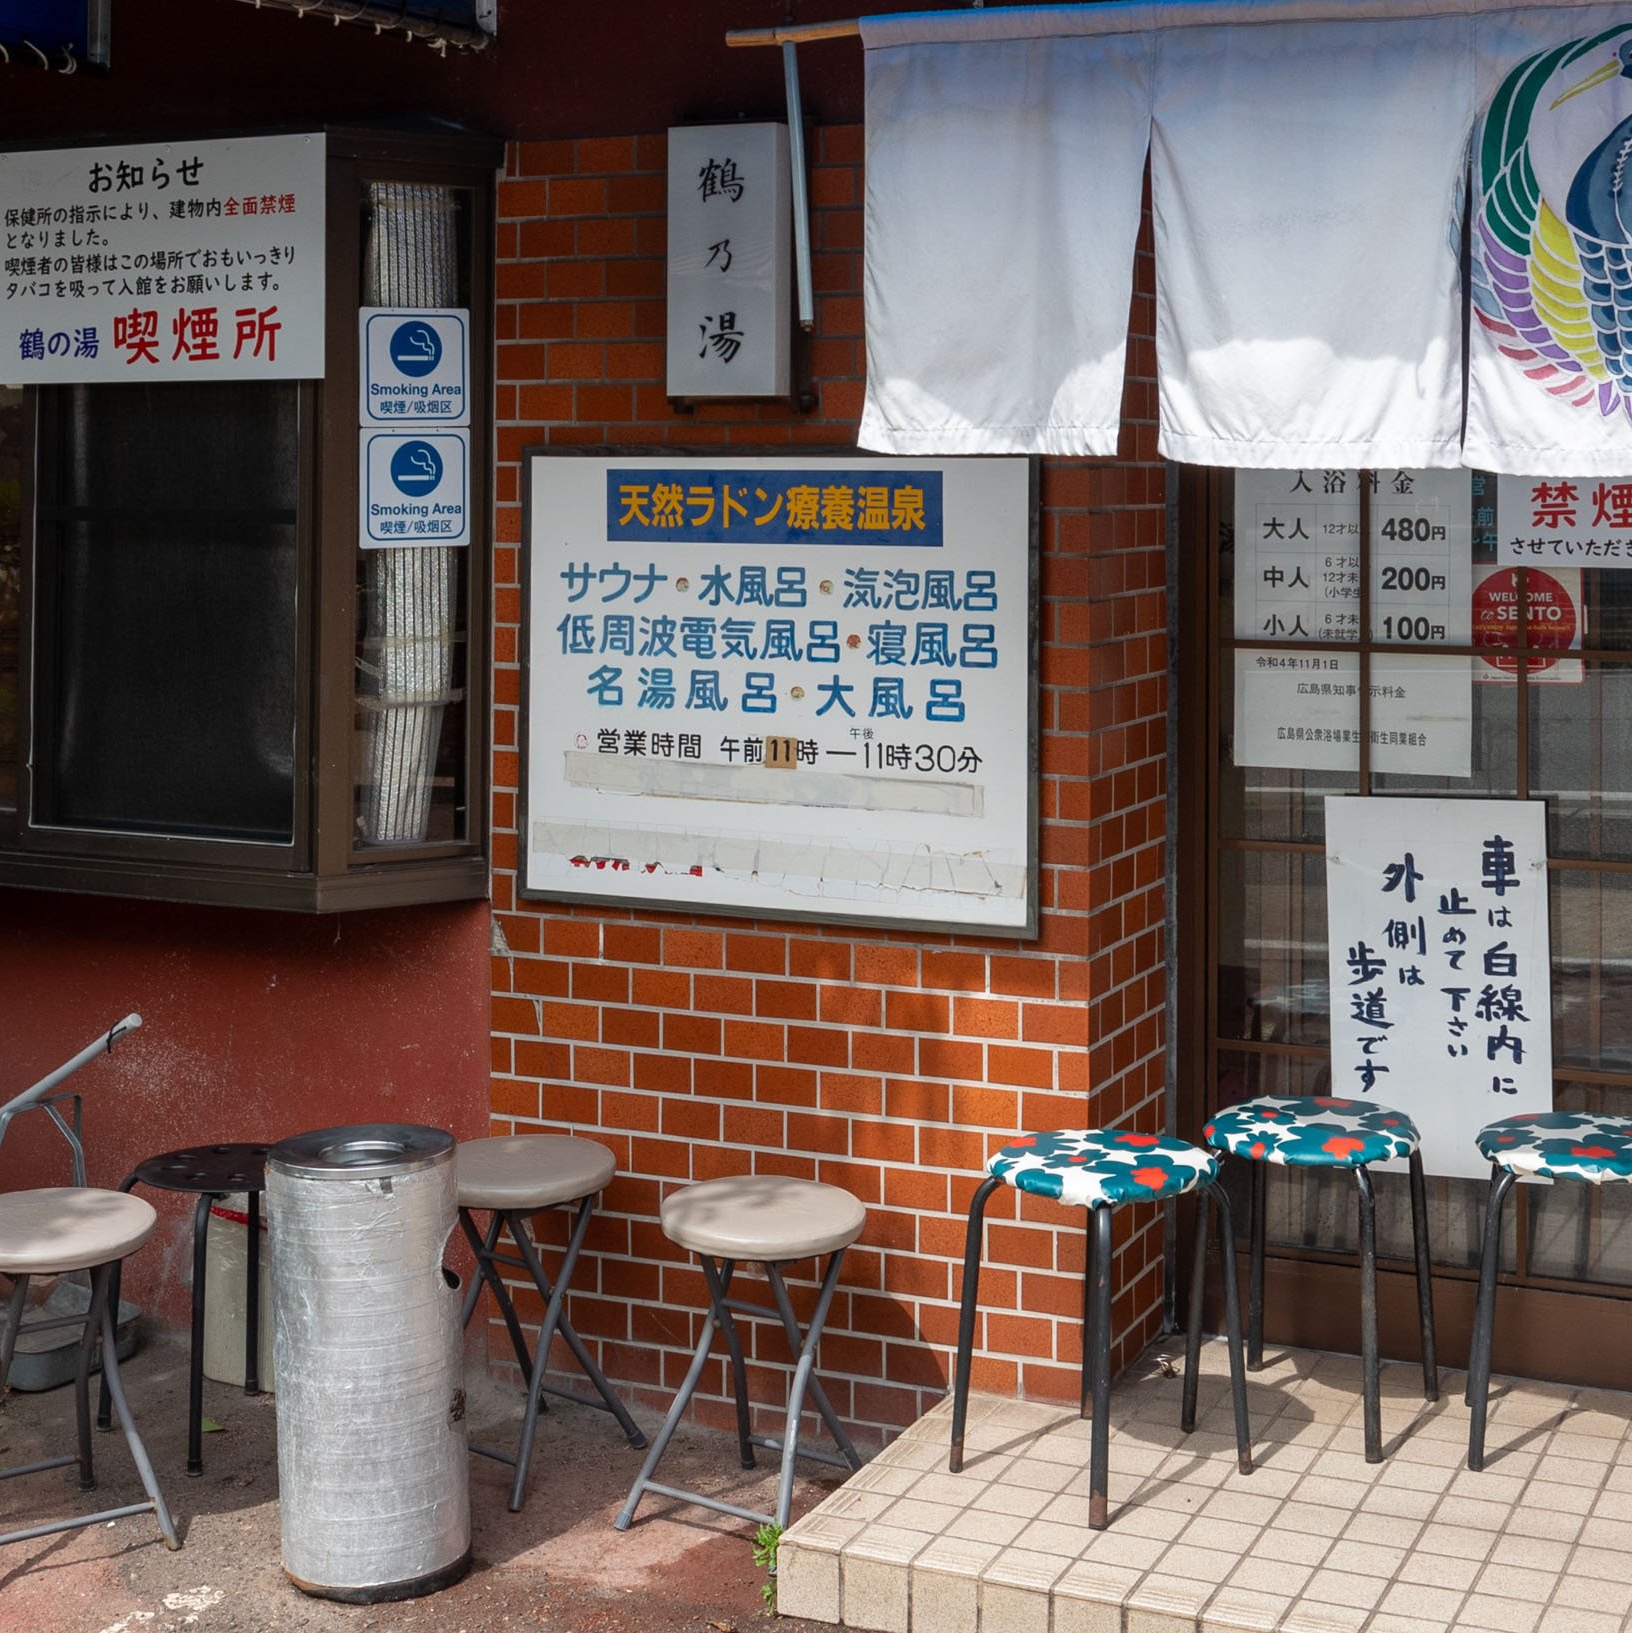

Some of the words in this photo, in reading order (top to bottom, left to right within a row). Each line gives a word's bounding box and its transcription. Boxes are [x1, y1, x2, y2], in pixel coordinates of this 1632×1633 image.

[88, 156, 204, 193] お知らせ
[4, 194, 296, 227] 保健所の指示により、建物内全面禁煙
[6, 228, 110, 249] となりました。
[4, 246, 296, 277] 喫煙者の皆様はこの場所でおもいっきり
[697, 158, 744, 364] 鶴乃湯
[6, 272, 281, 300] タバコを吸って入館をお願いします。
[19, 327, 100, 361] 鶴の湯
[113, 305, 282, 365] 喫煙所
[371, 383, 428, 397] Smoking
[432, 383, 461, 395] Area
[371, 503, 428, 518] Smoking
[432, 503, 462, 515] Area
[618, 484, 927, 531] 天然ラドン療養温泉
[1263, 517, 1310, 540] 大人
[1323, 523, 1359, 535] 12才以
[1381, 518, 1446, 542] 480円
[1263, 566, 1310, 588] 中人
[1323, 572, 1359, 583] 12才未
[1381, 567, 1446, 591] 200円
[1489, 592, 1553, 603] WELOME
[1263, 614, 1309, 637] 小人
[1383, 617, 1445, 640] 100円
[1256, 656, 1339, 671] 令和4年11月1日
[1297, 683, 1406, 698] 広島県知事示料金
[597, 728, 702, 759] 営業時間
[849, 727, 874, 742] 午後
[1277, 727, 1427, 747] 広島県公衆浴場業生衛生同業組合
[1381, 851, 1427, 987] 外側は
[1437, 887, 1477, 1059] 止めて下さい
[1475, 834, 1531, 1095] 車は白線内に
[1346, 940, 1396, 1094] 歩道です
